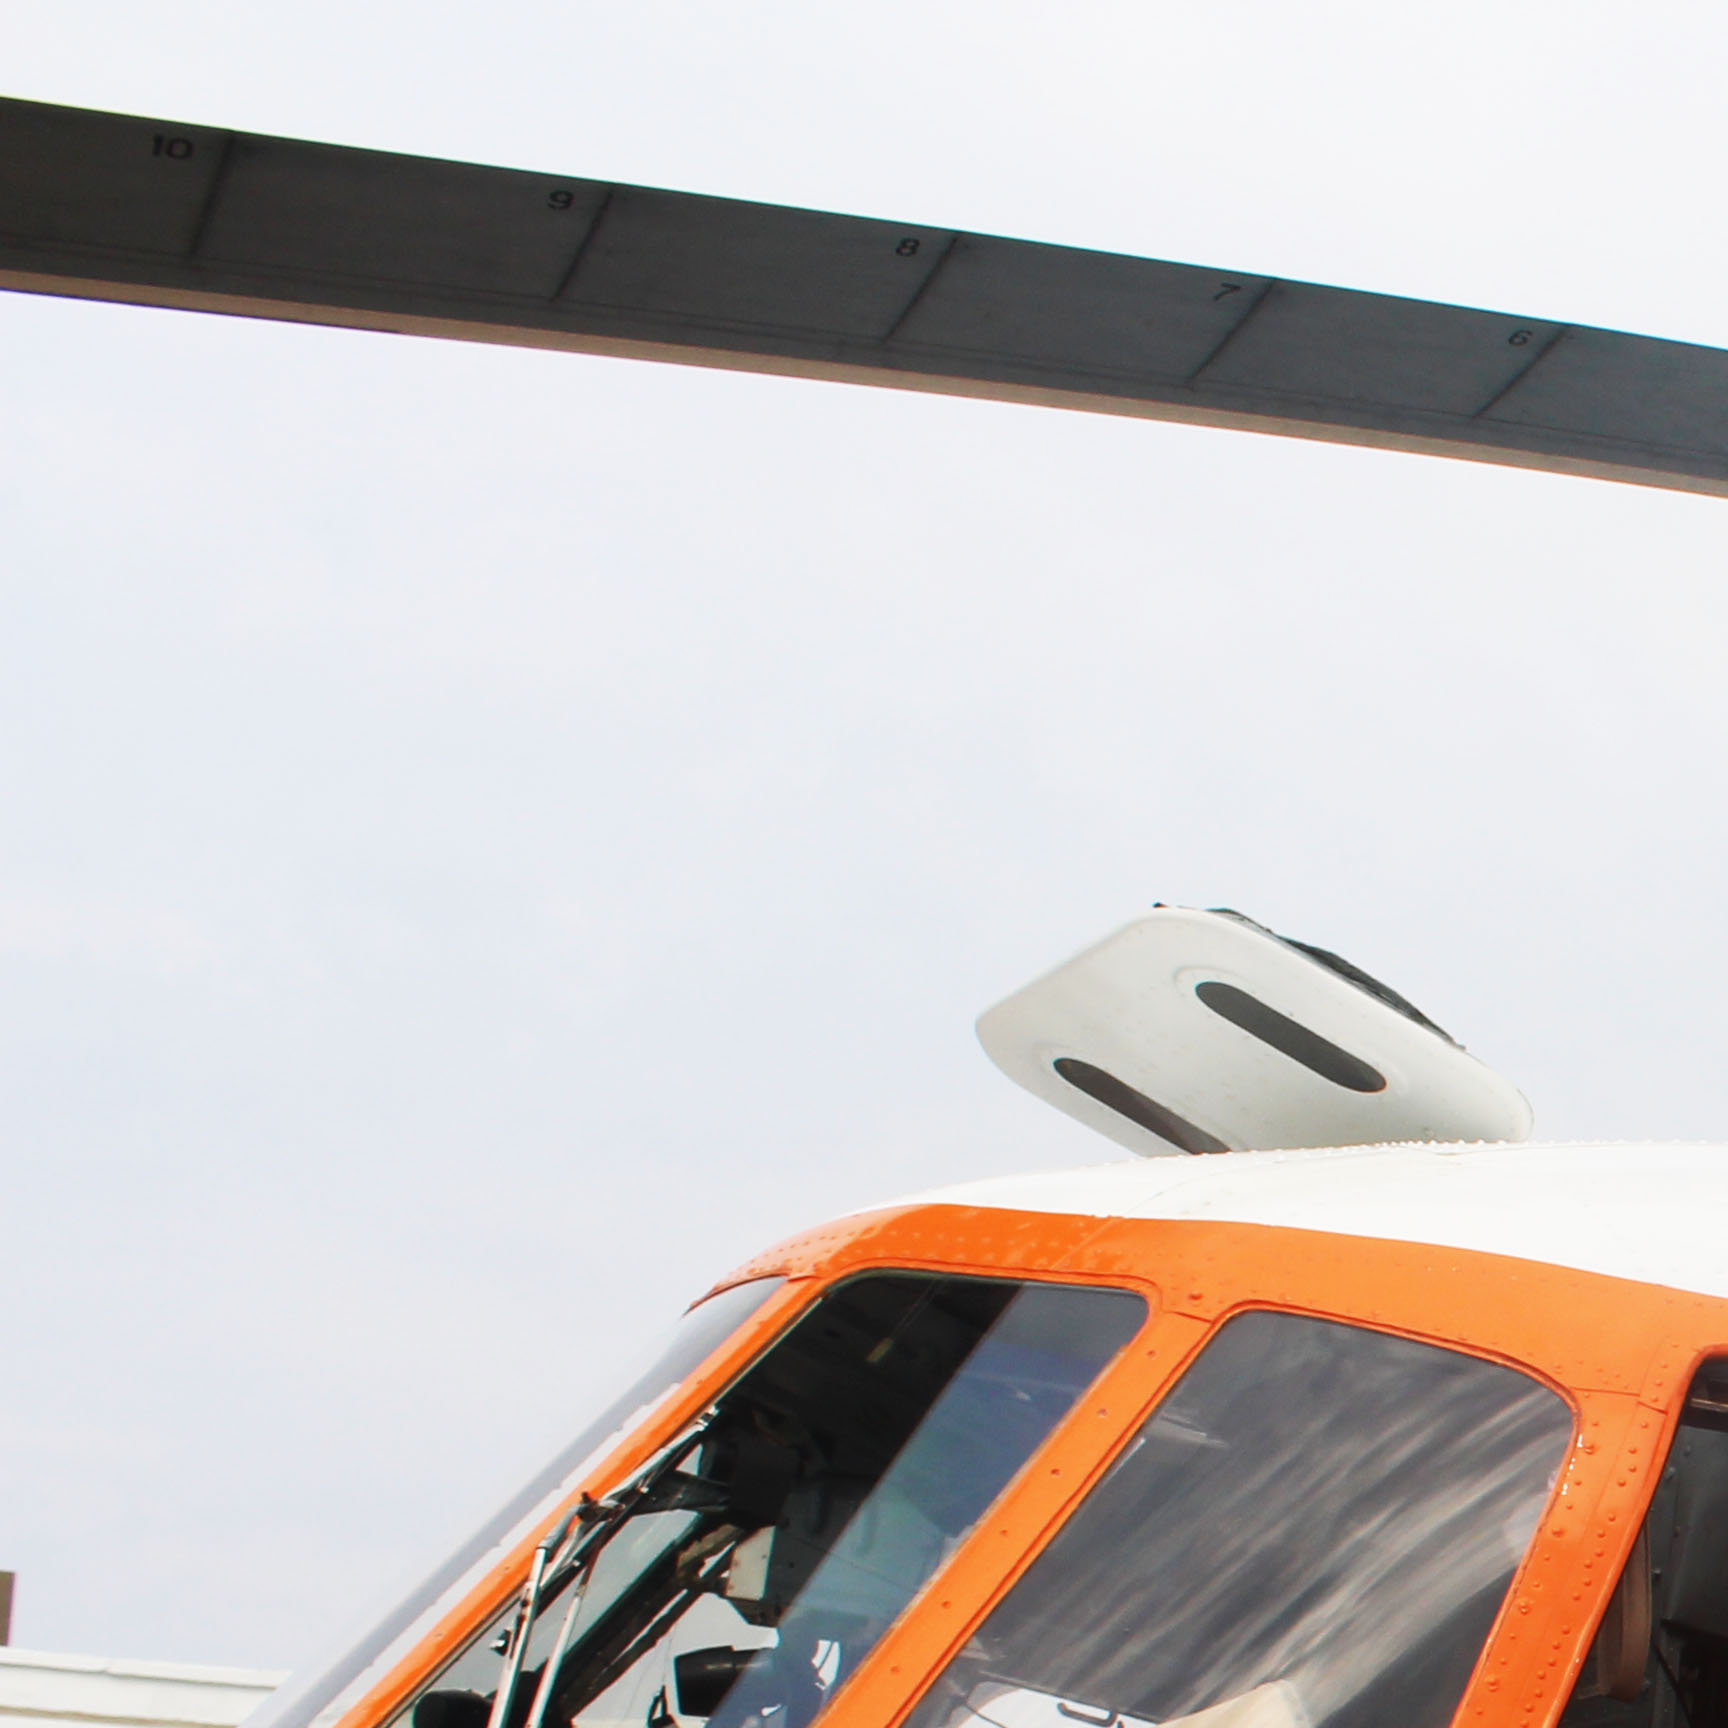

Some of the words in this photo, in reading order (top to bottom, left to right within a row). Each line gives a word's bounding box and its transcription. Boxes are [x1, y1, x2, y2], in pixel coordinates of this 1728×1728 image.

[152, 135, 194, 160] 10
[546, 190, 574, 211] 9
[895, 238, 921, 258] 8
[1213, 282, 1241, 302] 7
[1508, 329, 1534, 347] 6
